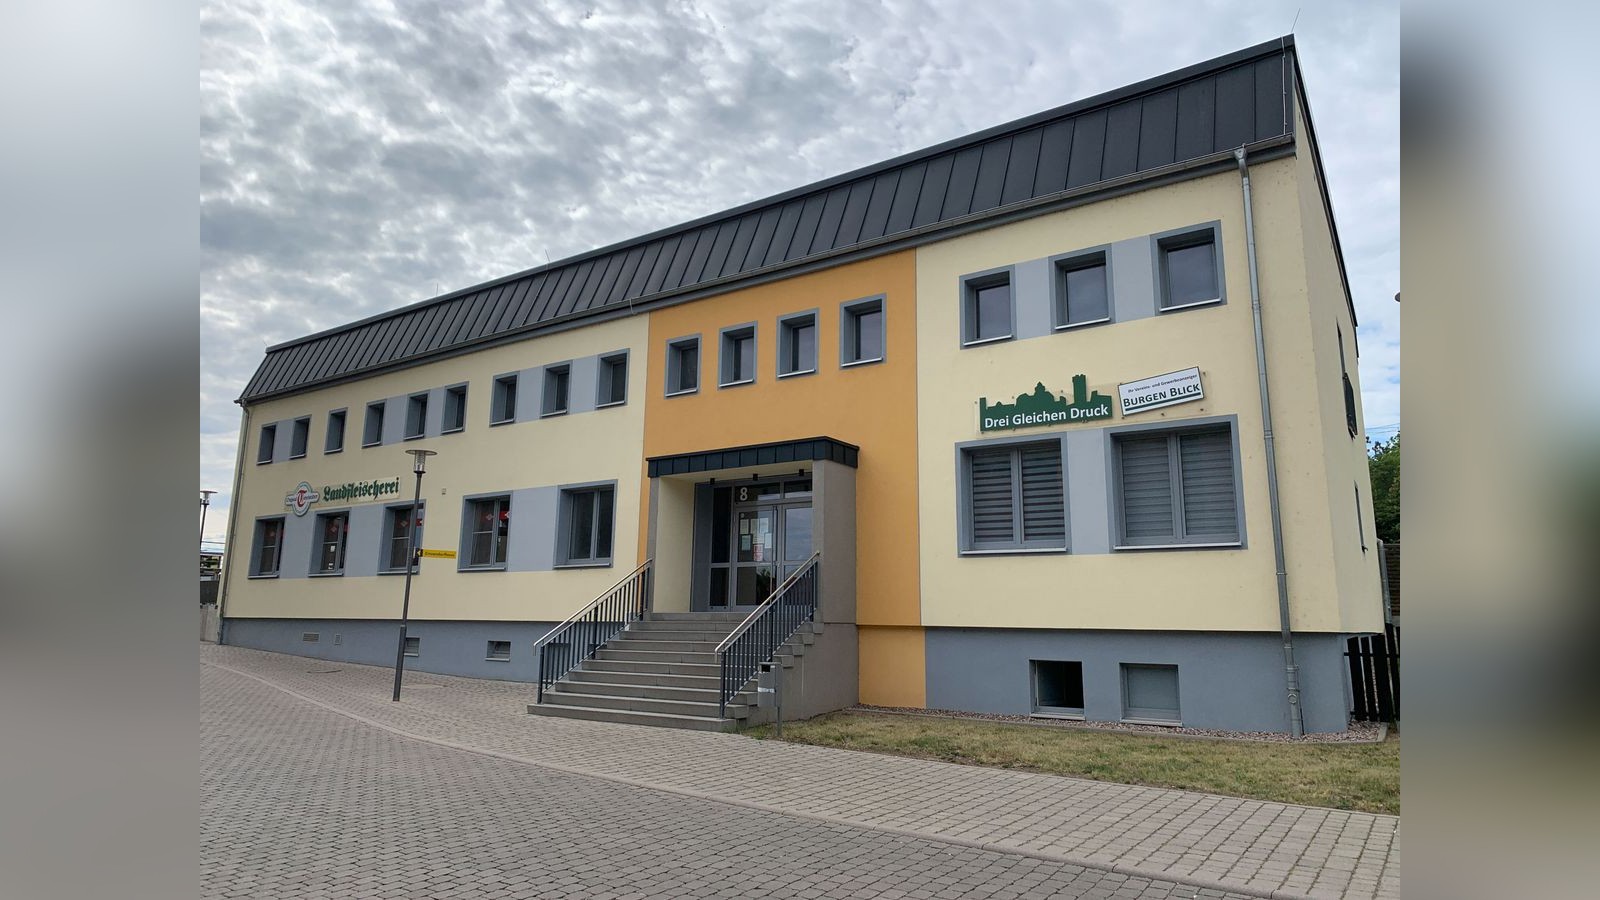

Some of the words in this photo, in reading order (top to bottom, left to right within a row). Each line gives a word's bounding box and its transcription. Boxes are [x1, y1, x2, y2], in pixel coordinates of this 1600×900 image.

[1161, 374, 1198, 386] Gewerbeanzeiger
[1123, 391, 1167, 407] BURGEN
[1170, 383, 1200, 397] BLICK
[985, 415, 1009, 429] Drei
[1013, 410, 1067, 425] Gleichen
[1070, 404, 1109, 419] Druck
[323, 477, 400, 502] Landfleischerei
[740, 487, 748, 501] 8
